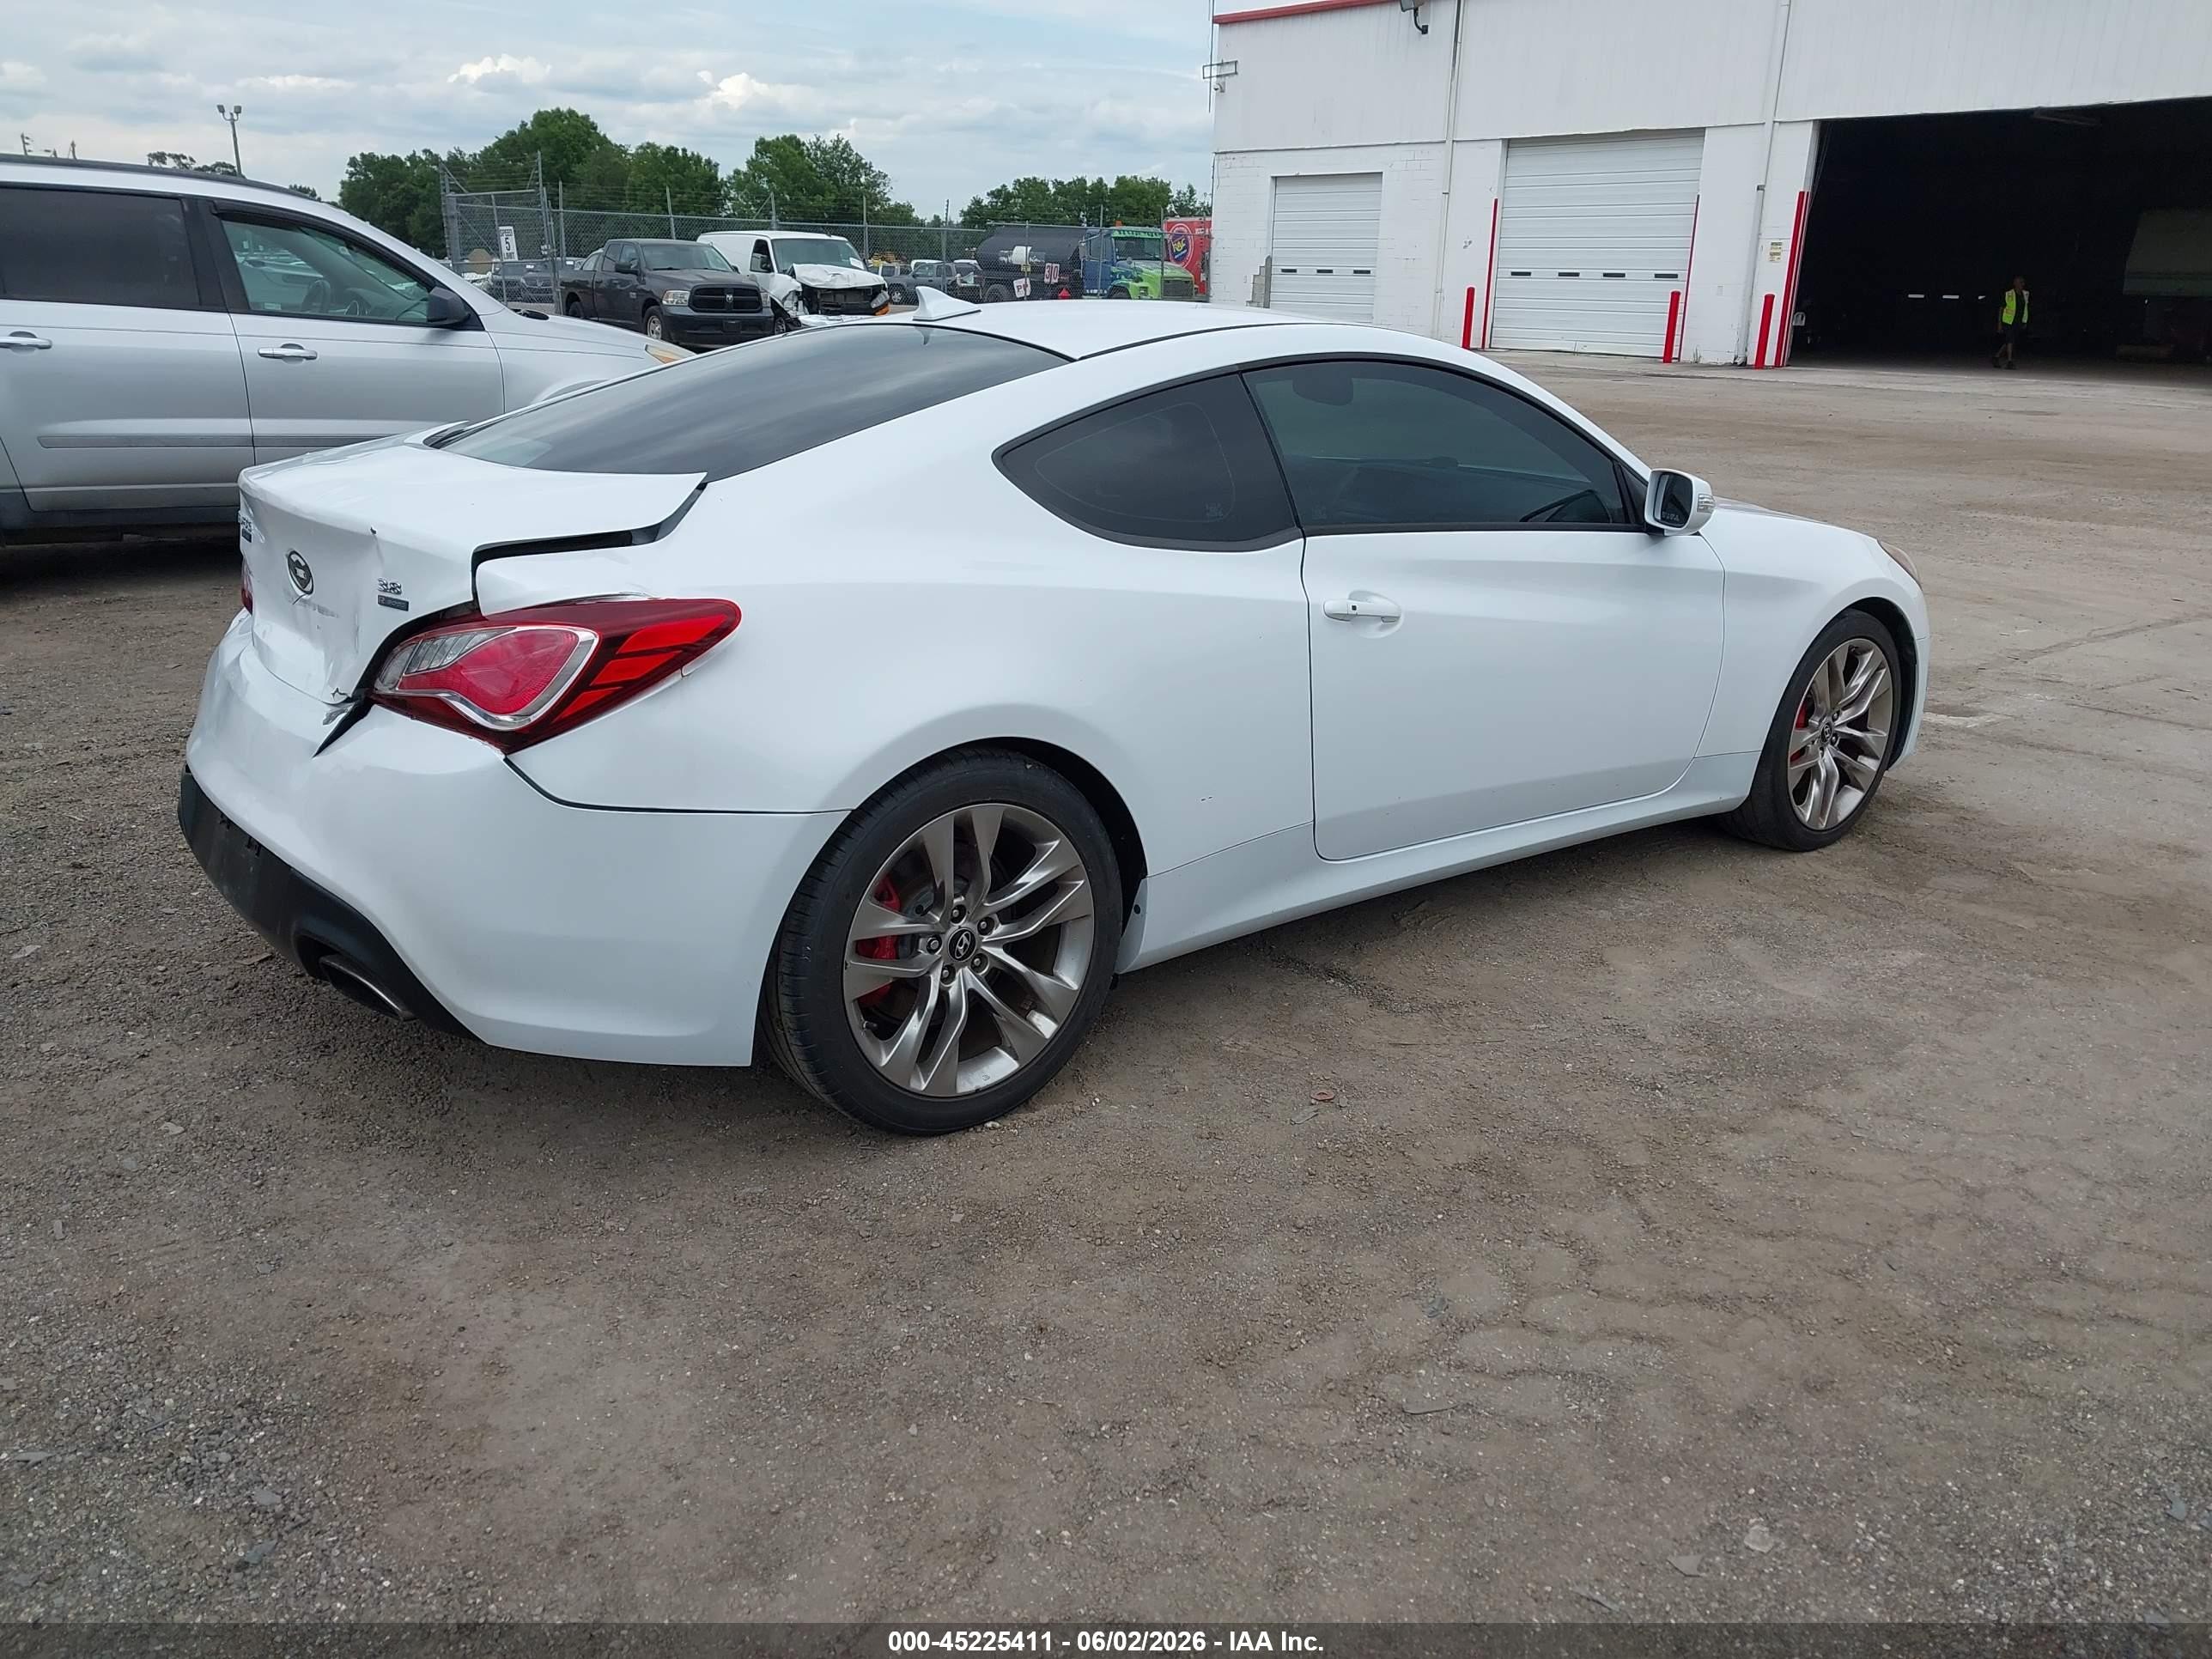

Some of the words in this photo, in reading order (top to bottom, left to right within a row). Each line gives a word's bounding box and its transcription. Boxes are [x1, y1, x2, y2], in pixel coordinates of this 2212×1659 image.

[500, 228, 514, 237] SPEED
[505, 237, 511, 252] 5
[503, 252, 515, 260] LIMIT
[377, 576, 403, 595] 3.8
